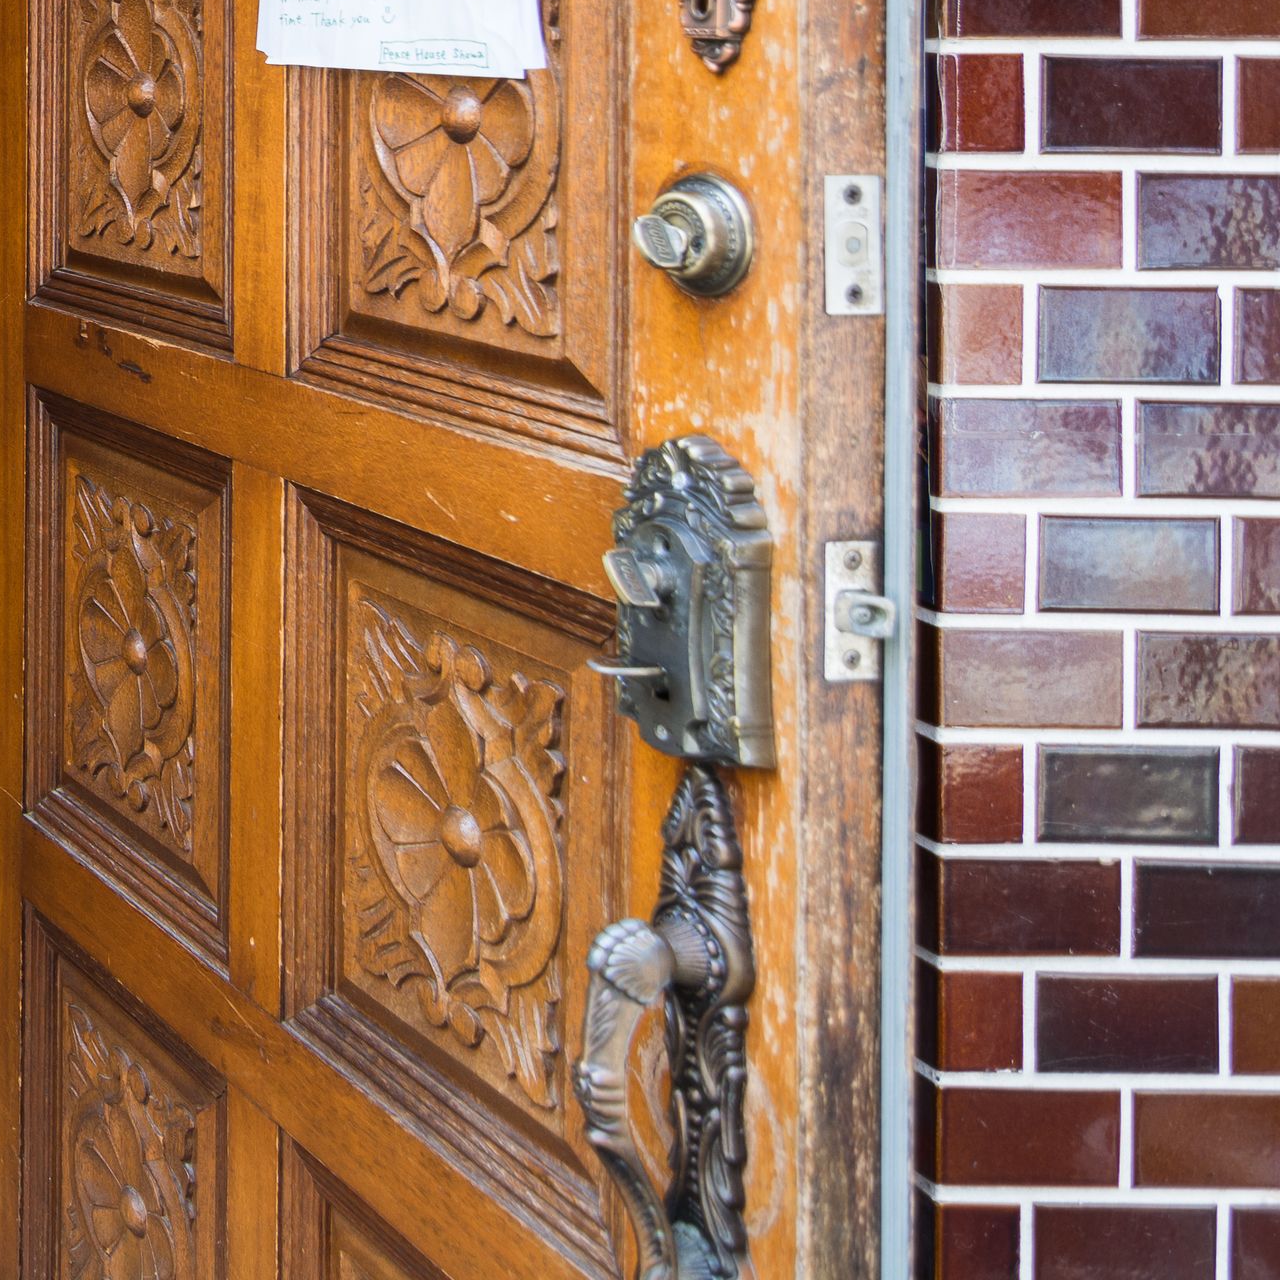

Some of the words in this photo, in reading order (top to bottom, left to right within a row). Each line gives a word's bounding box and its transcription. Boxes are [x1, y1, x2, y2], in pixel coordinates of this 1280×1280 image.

[310, 9, 345, 28] Thank
[351, 16, 370, 28] you
[414, 47, 446, 61] House
